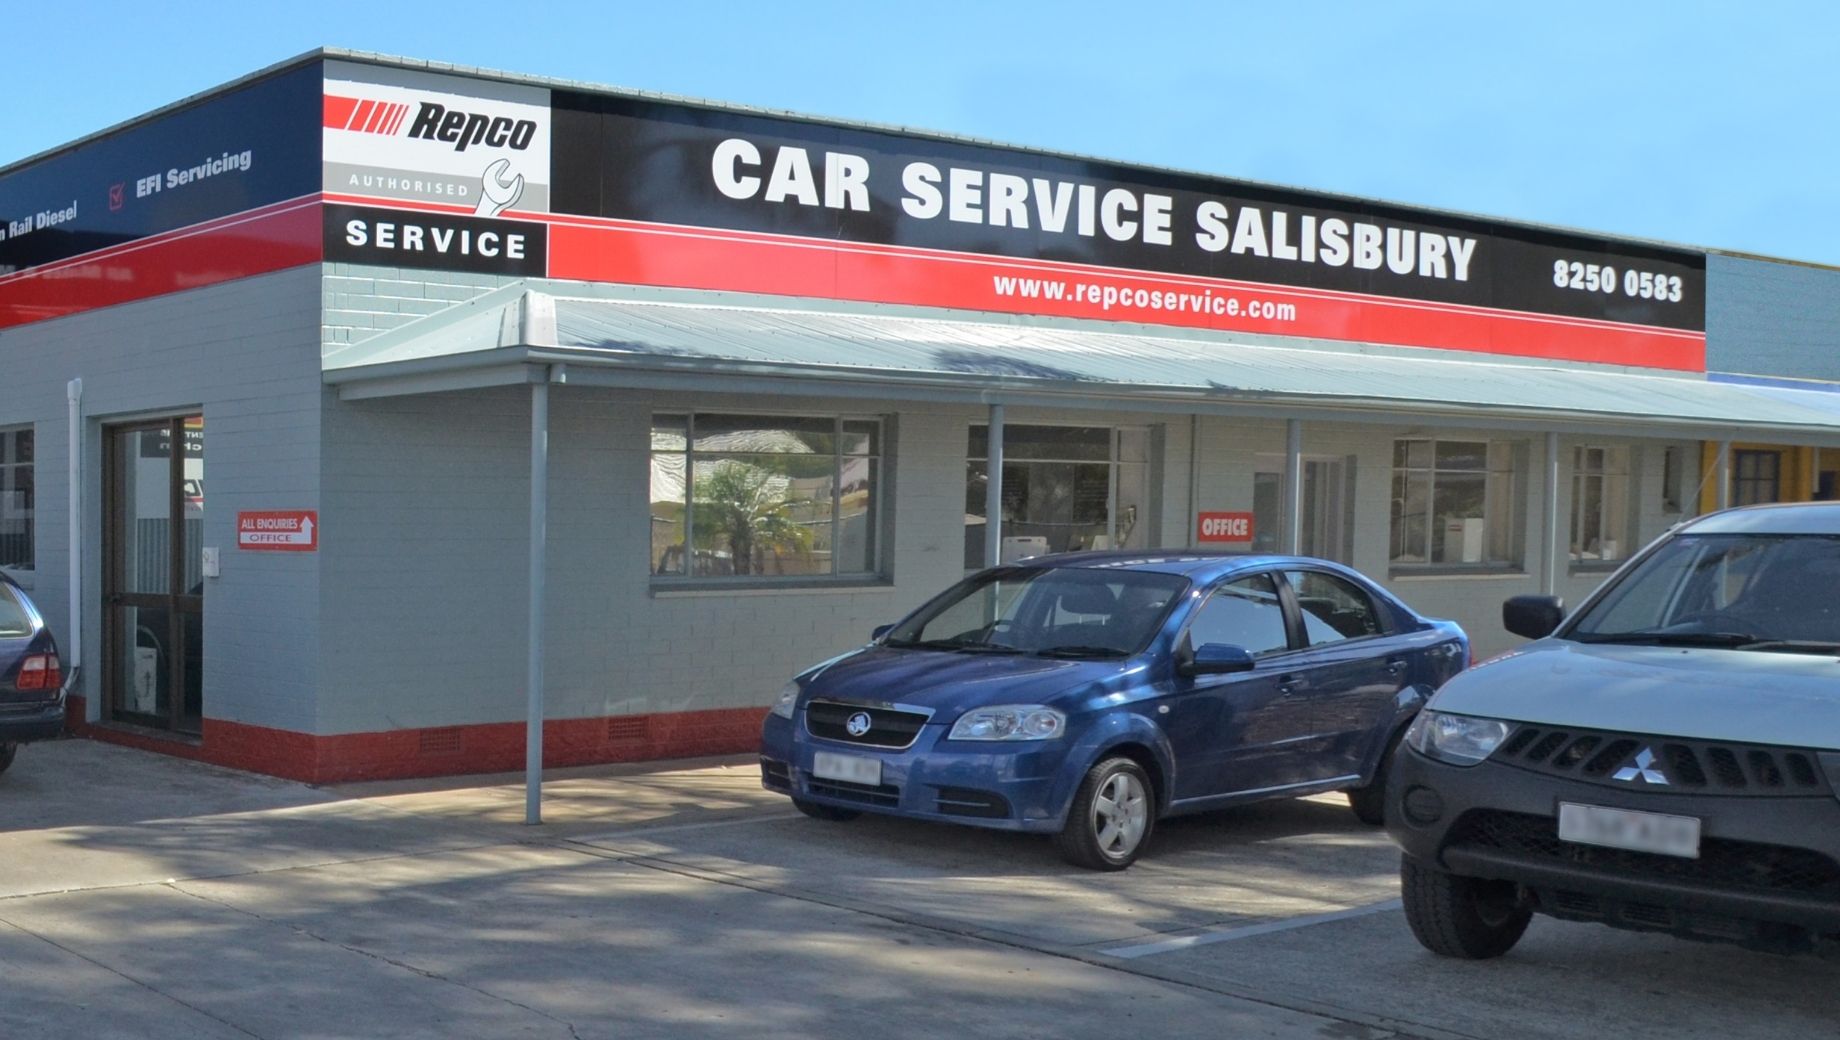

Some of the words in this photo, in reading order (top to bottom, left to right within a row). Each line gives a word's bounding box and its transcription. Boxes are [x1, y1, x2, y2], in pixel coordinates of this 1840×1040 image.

[407, 101, 538, 152] Repco
[136, 173, 162, 198] EFI
[166, 149, 252, 189] Servicing
[349, 173, 469, 196] AUTHORISED
[9, 214, 33, 239] Rail
[36, 200, 77, 230] Diesel
[711, 137, 871, 213] CAR
[900, 161, 1173, 247] SERVICE
[1195, 200, 1478, 282] SALISBURY
[345, 219, 526, 260] SERVICE
[993, 275, 1297, 322] www.repcoservice.com
[1553, 259, 1616, 294] 8250
[1624, 268, 1683, 302] 0583
[241, 518, 255, 529] ALL
[256, 518, 298, 529] ENQUIRIES
[249, 534, 292, 542] OFFICE
[1202, 518, 1248, 536] OFFICE
